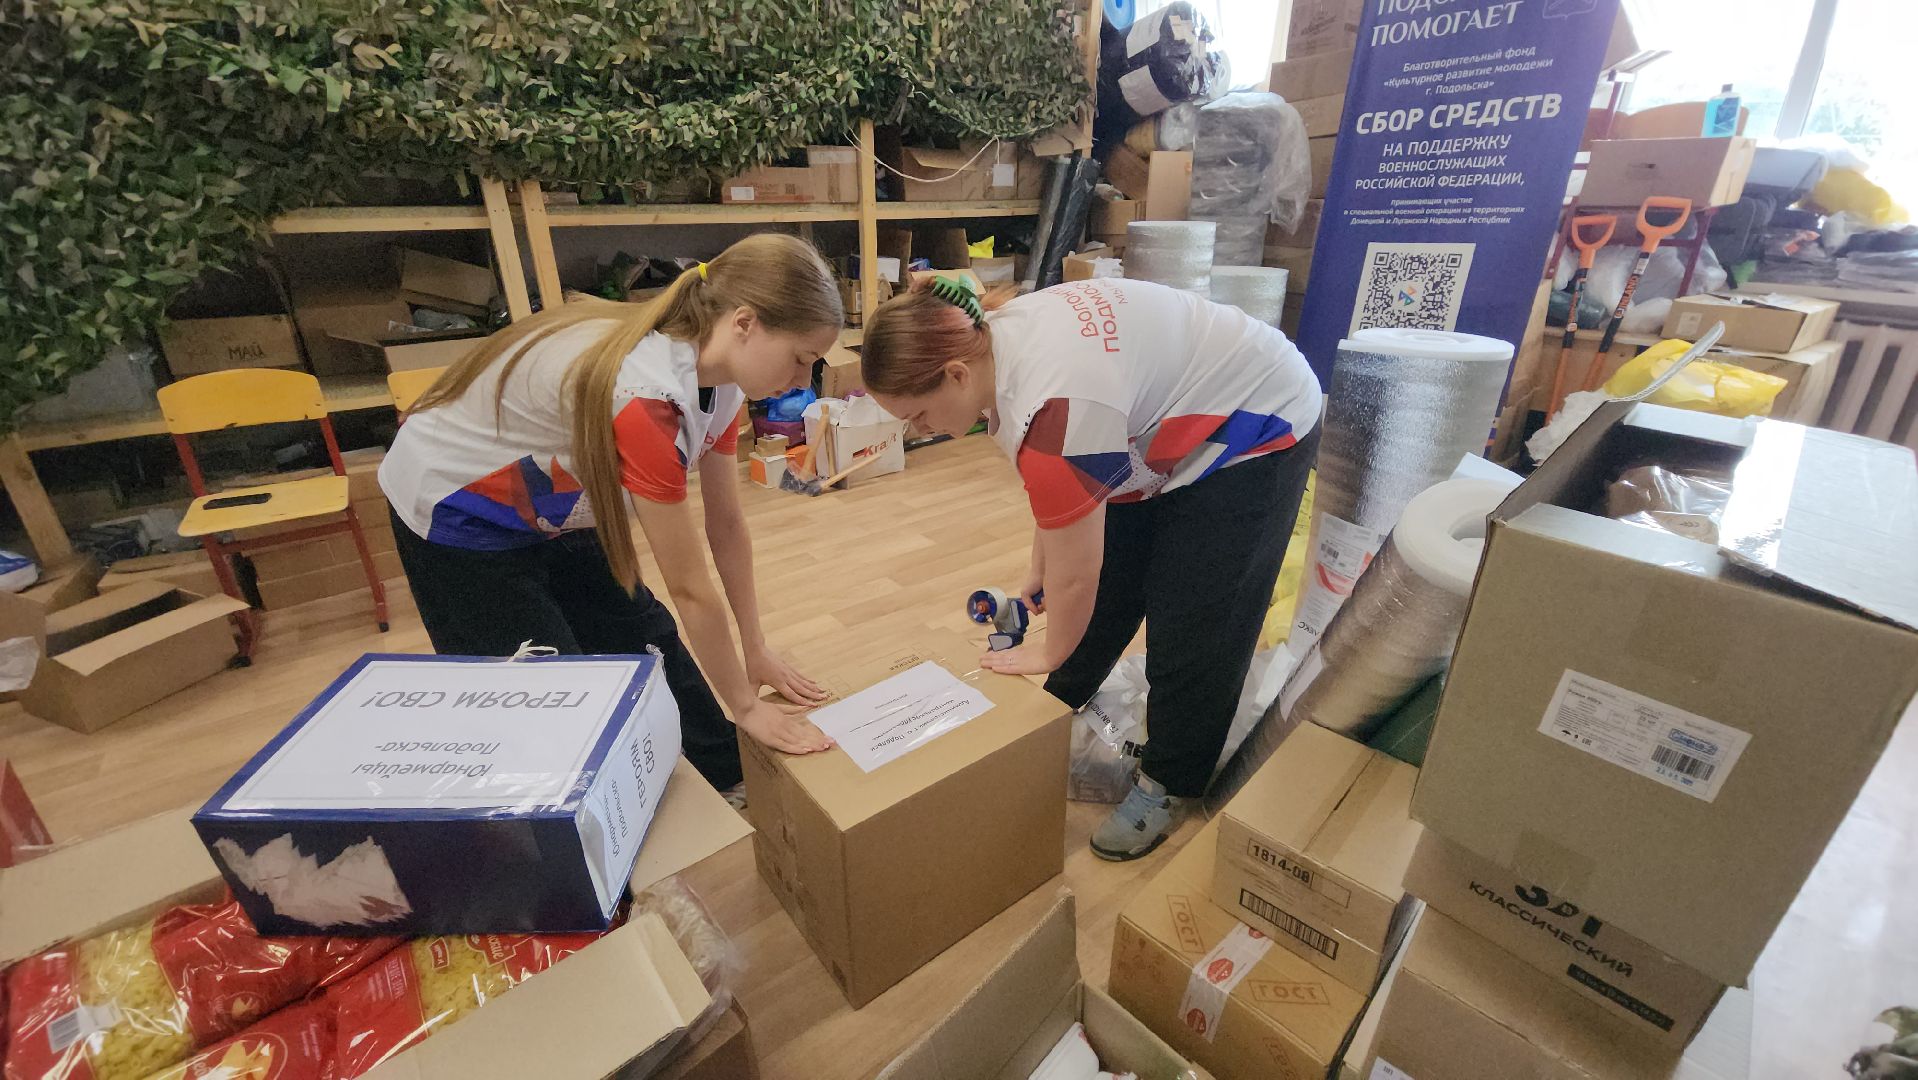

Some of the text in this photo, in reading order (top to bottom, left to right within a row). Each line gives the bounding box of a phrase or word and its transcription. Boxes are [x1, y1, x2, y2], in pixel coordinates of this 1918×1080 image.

[1371, 1, 1525, 47] ПОМОГАЕТ
[1403, 46, 1536, 73] Благотворительный фонд
[1384, 58, 1554, 89] «Культурное развитие молодежи
[1434, 80, 1495, 95] Подольска»
[1356, 93, 1563, 135] СБОР СРЕДСТВ
[1383, 134, 1512, 157] НА ПОДДЕРЖКУ
[1379, 155, 1508, 174] ВОЕННОСЛУЖАЩИХ
[1355, 172, 1526, 190] РОССИЙСКОЙ ФЕДЕРАЦИИ,
[1430, 216, 1466, 225] Народных
[1468, 215, 1511, 225] Республик
[1075, 283, 1120, 352] Подмос
[360, 691, 590, 708] ГЕРОЯМ СВО!
[375, 742, 501, 755] Подольска-
[643, 732, 655, 774] СВО!
[352, 761, 493, 778] Юнармейцы
[630, 737, 647, 808] ГЕРОЯМ
[1253, 845, 1311, 883] 1814-08
[1173, 901, 1198, 947] ГОСТ
[1469, 881, 1634, 978] КЛАССИЧЕСКИЙ
[1257, 983, 1317, 1000] ГОСТ
